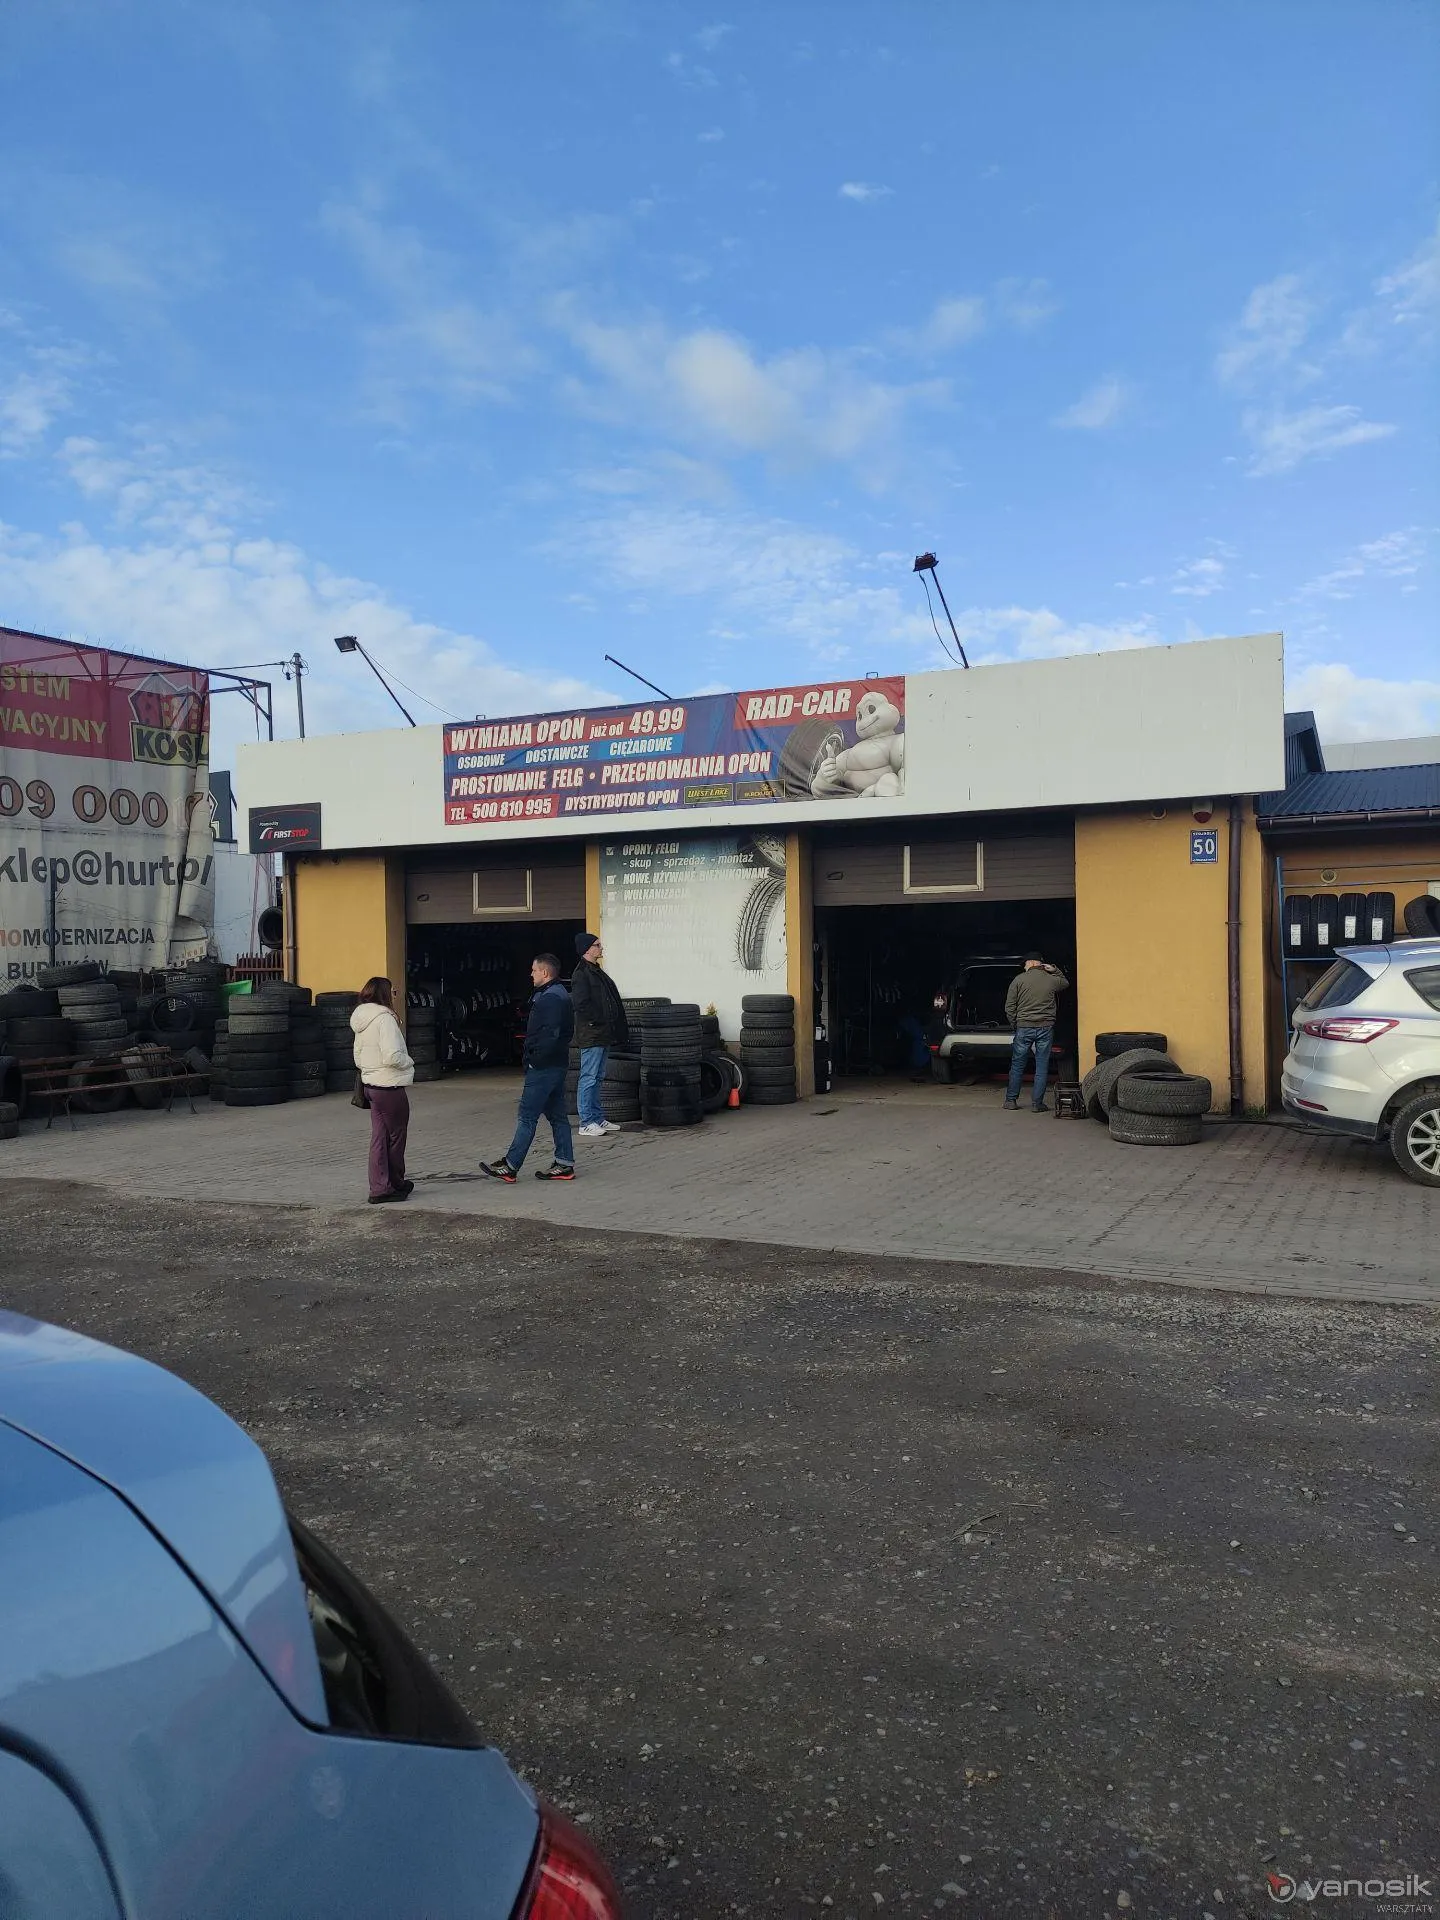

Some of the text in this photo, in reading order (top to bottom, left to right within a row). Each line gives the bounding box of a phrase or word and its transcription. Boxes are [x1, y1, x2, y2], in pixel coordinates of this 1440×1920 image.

[746, 688, 852, 721] RAD-CAR
[451, 707, 685, 751] WYMIANA OPON już od 49,99
[457, 736, 673, 770] OSOBOWE DOSTAWCZE CIĘŻAROWE
[451, 751, 772, 797] PROSTOWANIE FELG PRZECHOWALNIA OPON
[72, 784, 169, 829] 000
[450, 797, 552, 821] TEL. 500 810 995
[565, 789, 680, 811] DYSTRYBUTOR OPON
[622, 842, 680, 856] OPONY, FELGI
[1193, 838, 1215, 855] 50
[629, 851, 755, 870] skup sprzedaż montaż
[623, 872, 651, 885] NOWE,
